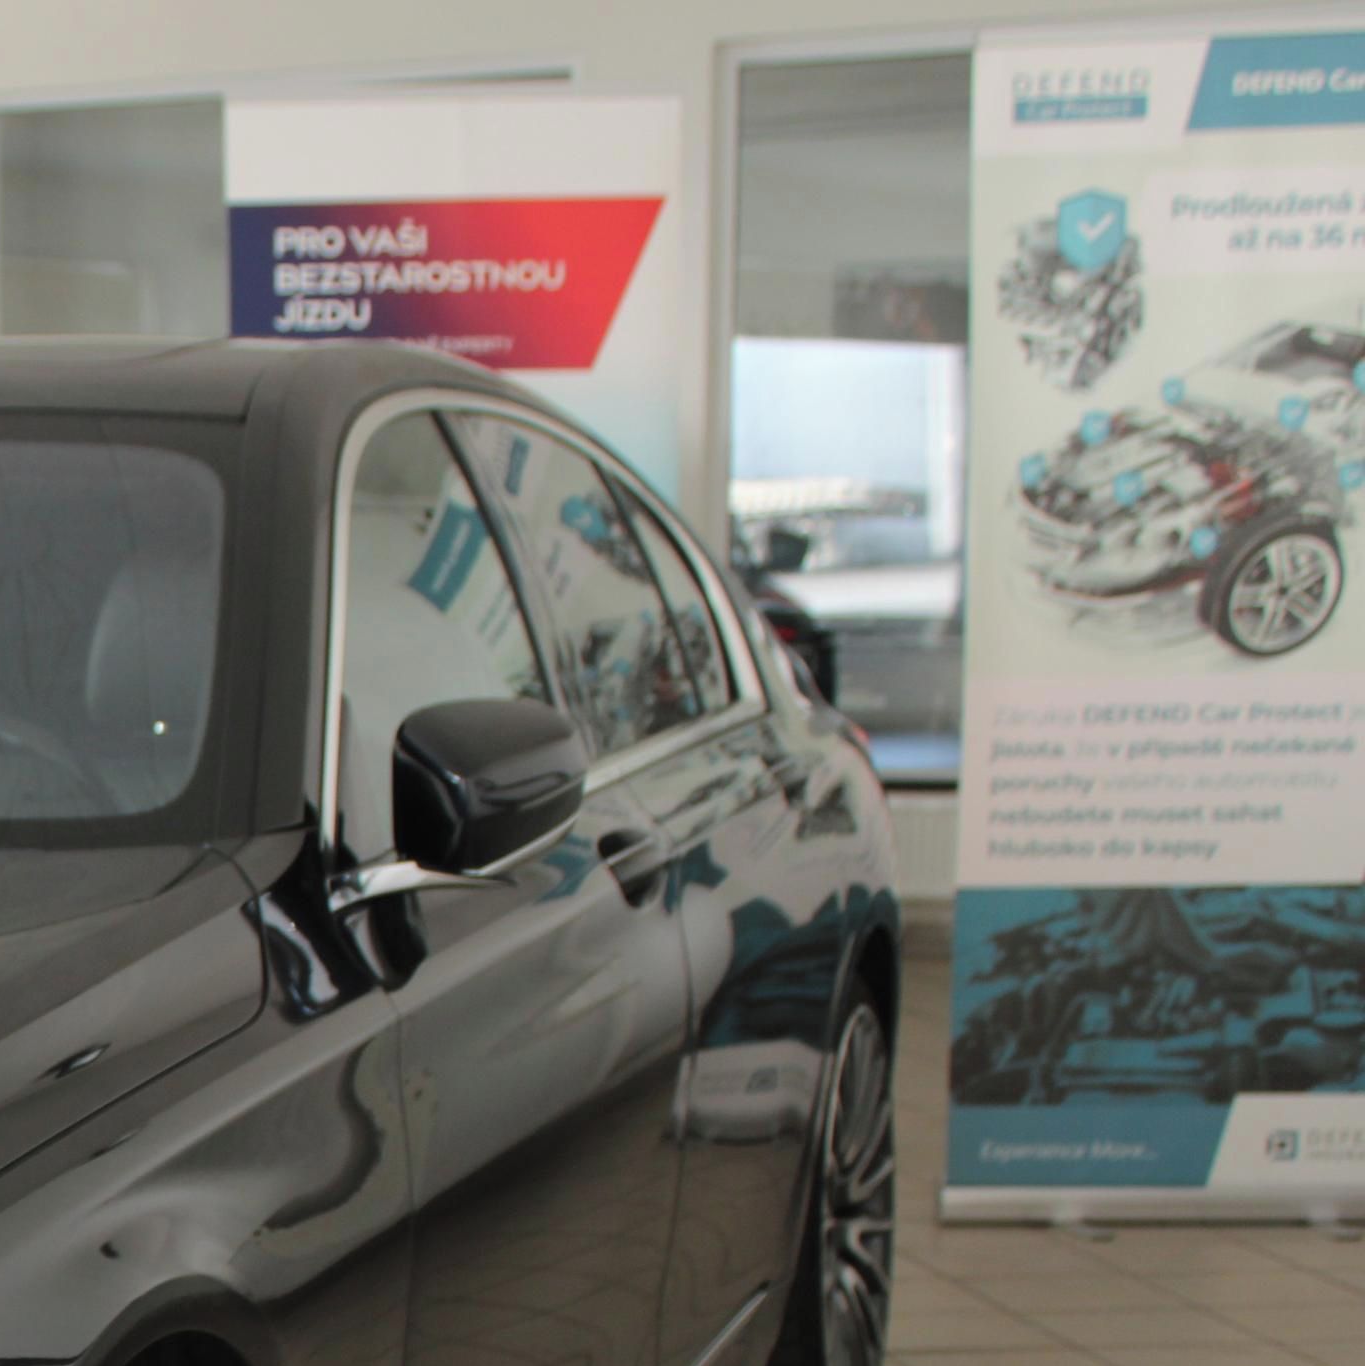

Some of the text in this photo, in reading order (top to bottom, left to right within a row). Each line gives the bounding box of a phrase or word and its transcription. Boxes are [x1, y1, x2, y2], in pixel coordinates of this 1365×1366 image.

[1232, 69, 1325, 96] DEFEND
[274, 216, 427, 257] PRO VAŠI
[275, 259, 566, 295] BEZSTAROSTNOU
[274, 294, 371, 332] JÍZDU
